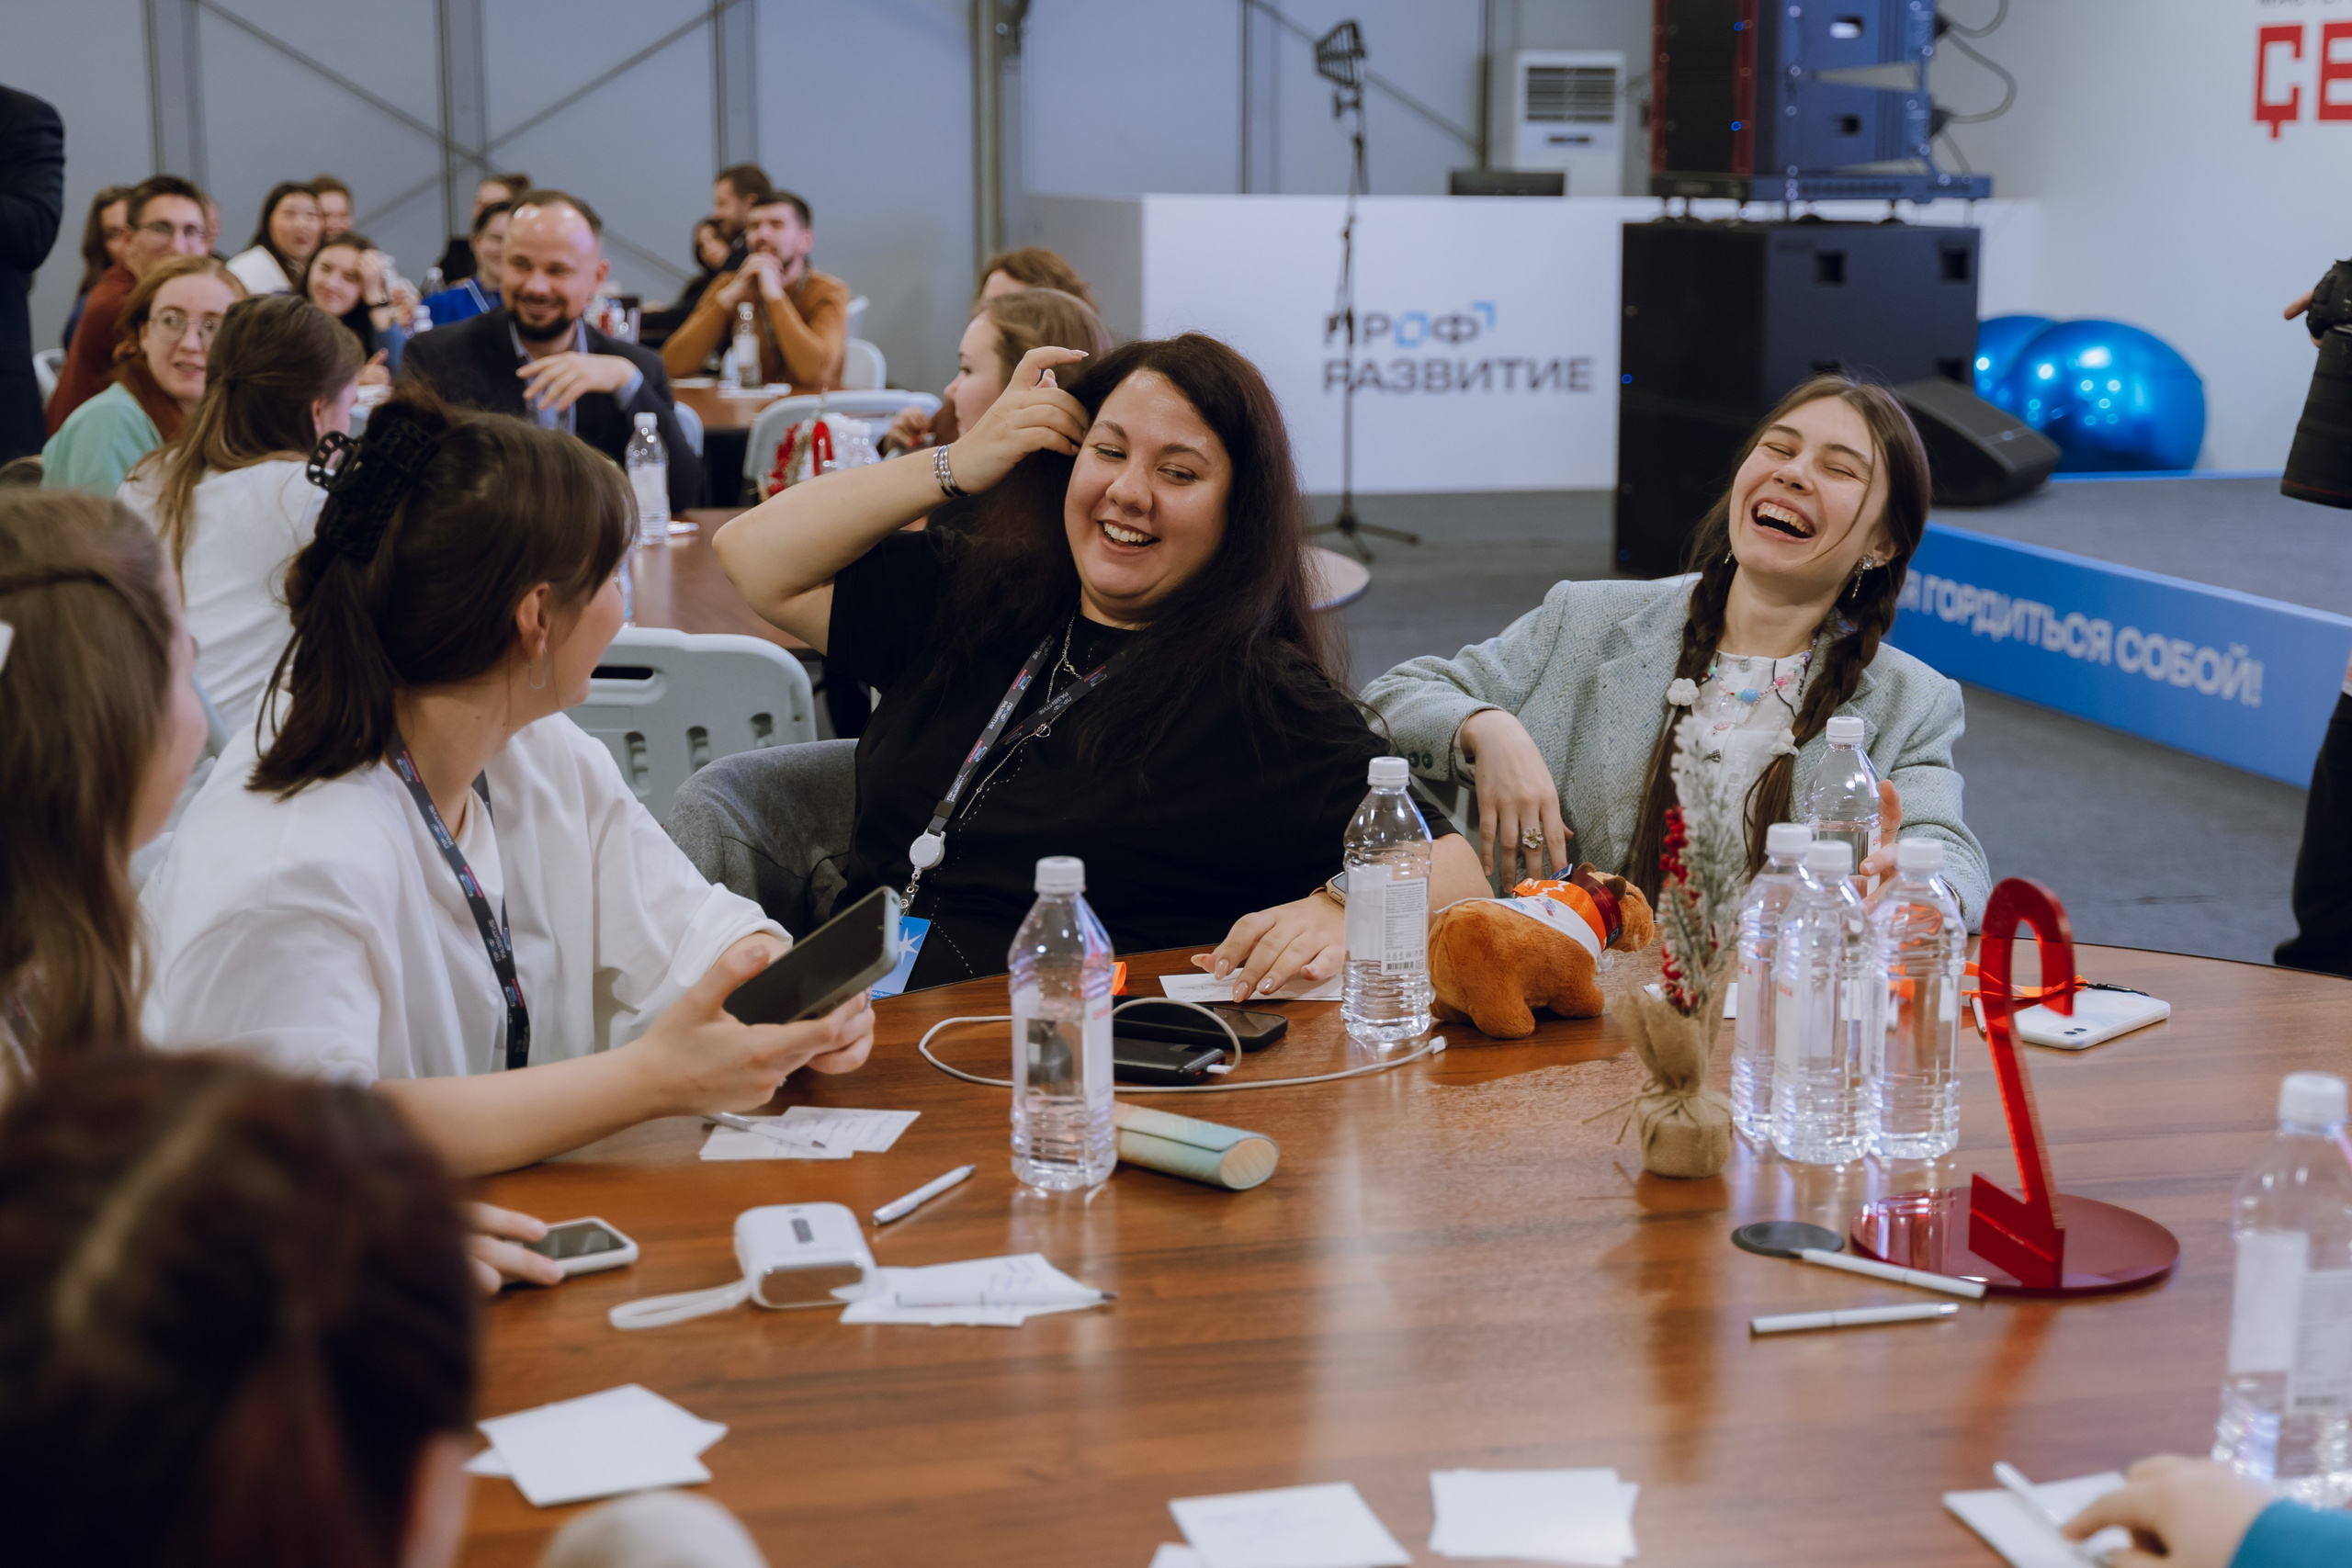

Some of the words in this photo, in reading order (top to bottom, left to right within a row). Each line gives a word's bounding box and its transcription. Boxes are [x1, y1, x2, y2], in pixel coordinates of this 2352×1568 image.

[1324, 358, 1594, 392] РАЗВИТИЕ
[1922, 573, 2114, 666] ГОРДИТЬСЯ
[2115, 626, 2265, 708] СОБОЙ!
[988, 700, 1008, 730] РАЗВИТИЕ
[488, 919, 507, 959] РАЗВИТИЕ
